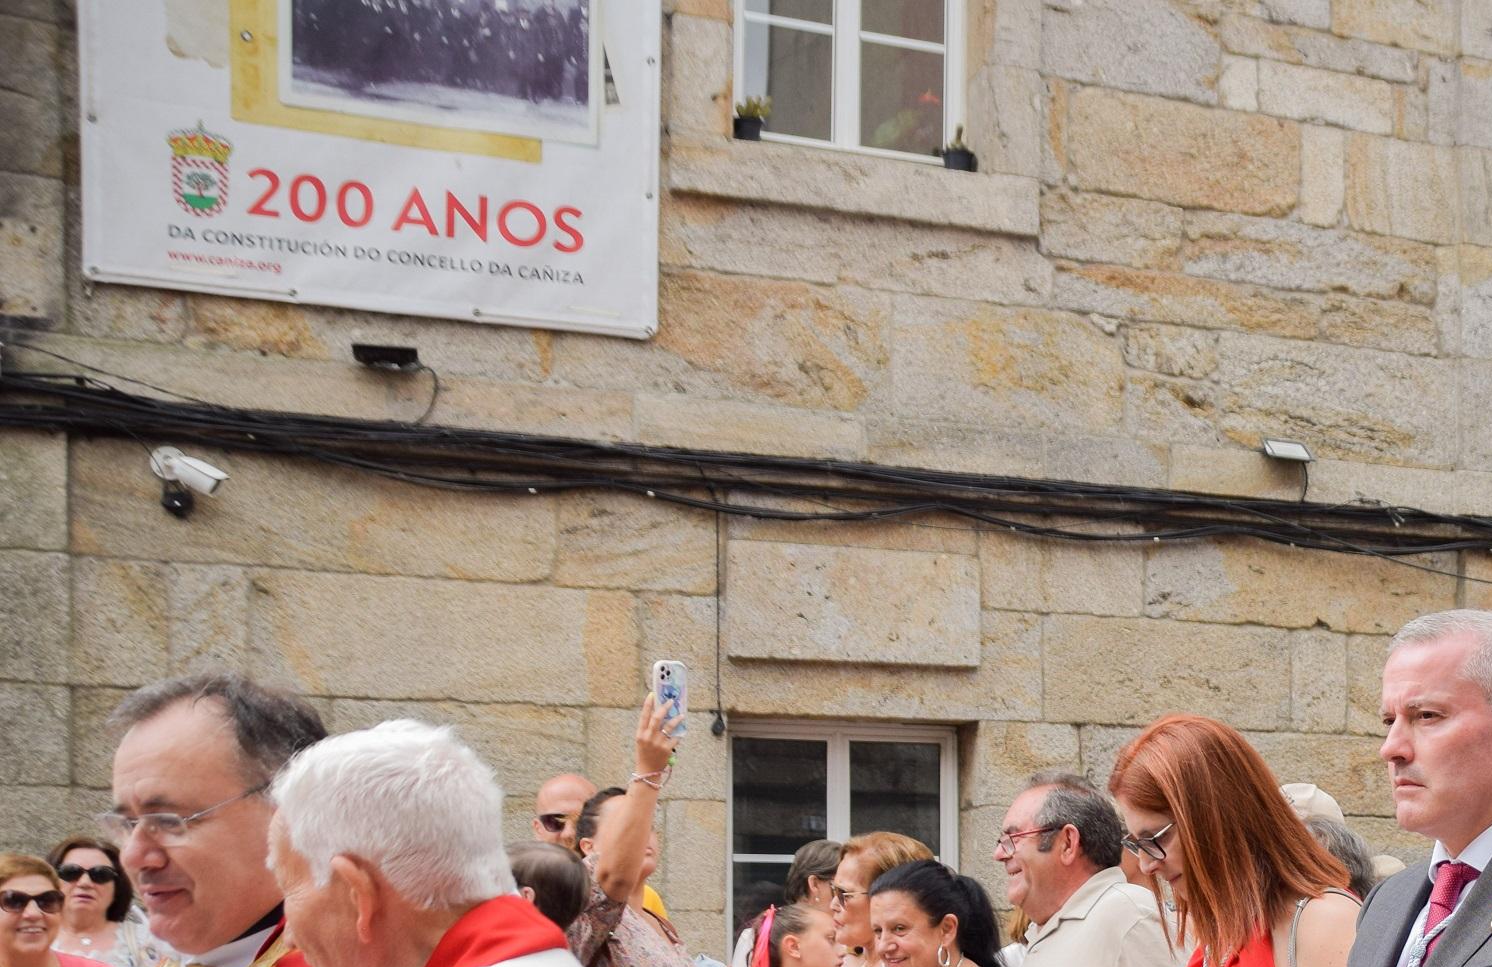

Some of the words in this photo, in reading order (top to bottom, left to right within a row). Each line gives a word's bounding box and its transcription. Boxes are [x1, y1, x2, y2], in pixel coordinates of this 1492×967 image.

[246, 167, 374, 229] 200
[391, 186, 585, 254] ANOS
[167, 223, 197, 241] DA
[202, 228, 347, 259] CONSTITUCIÓN
[353, 248, 381, 262] DO
[387, 250, 483, 274] CONCELLO
[488, 261, 513, 278] DA
[518, 264, 585, 285] CAÑIZA
